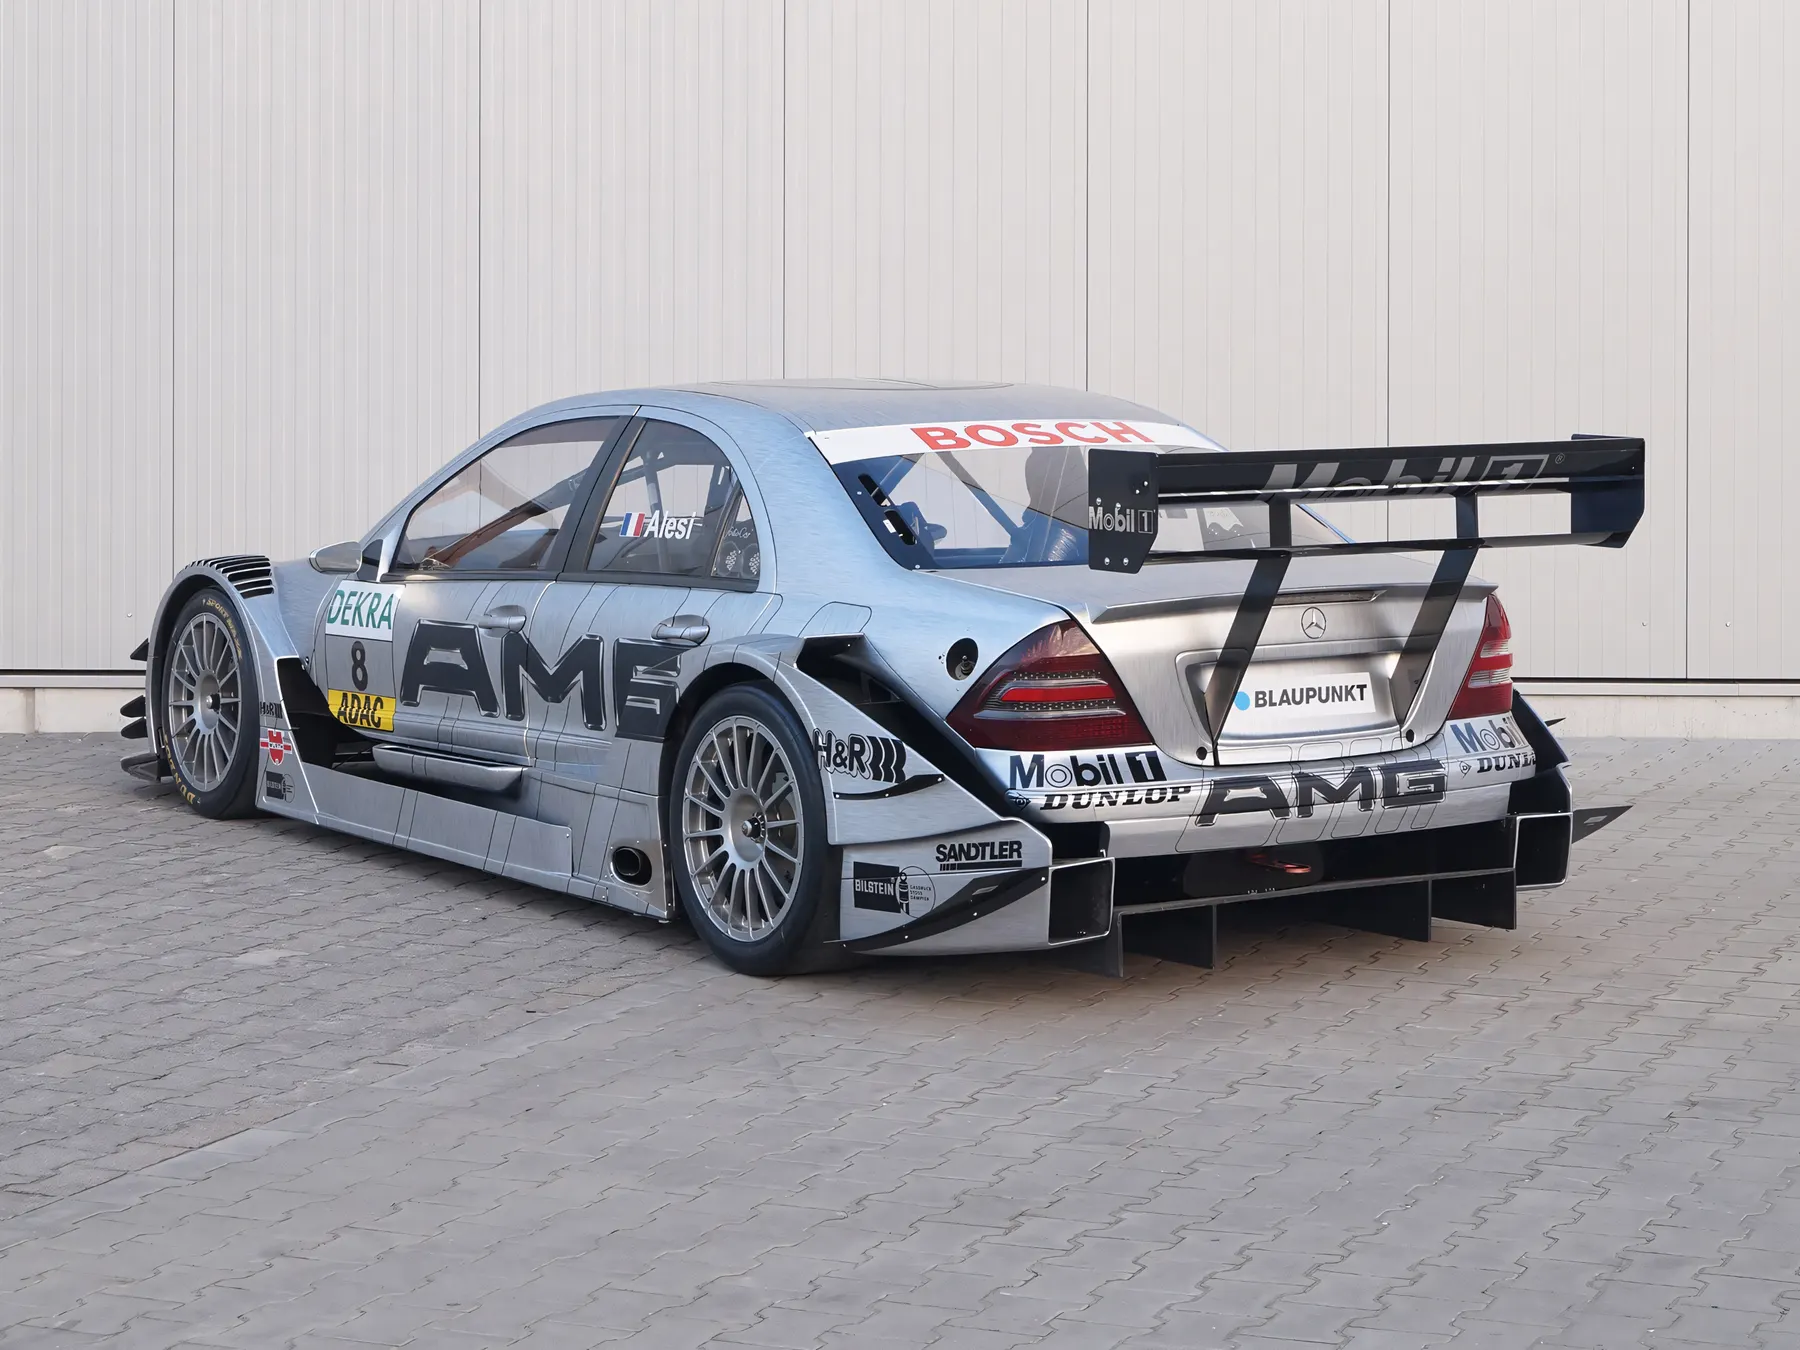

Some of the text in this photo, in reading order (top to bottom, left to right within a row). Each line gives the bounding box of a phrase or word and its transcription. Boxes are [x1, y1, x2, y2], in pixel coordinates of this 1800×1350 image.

[911, 421, 1155, 450] BOSCH
[1261, 457, 1476, 499] Mobil
[643, 510, 697, 540] Alesi
[1088, 506, 1135, 533] Mobil
[327, 589, 395, 630] DEKRA
[351, 641, 368, 691] 8
[337, 692, 384, 729] ADAC
[1254, 684, 1368, 708] BLAUPUNKT
[813, 728, 872, 780] H&R
[1010, 753, 1125, 789] Mobil
[1040, 786, 1192, 811] DUNLOP
[1195, 759, 1446, 827] AMG
[936, 841, 1022, 862] SANDTLER
[854, 880, 894, 896] BILSTEIN
